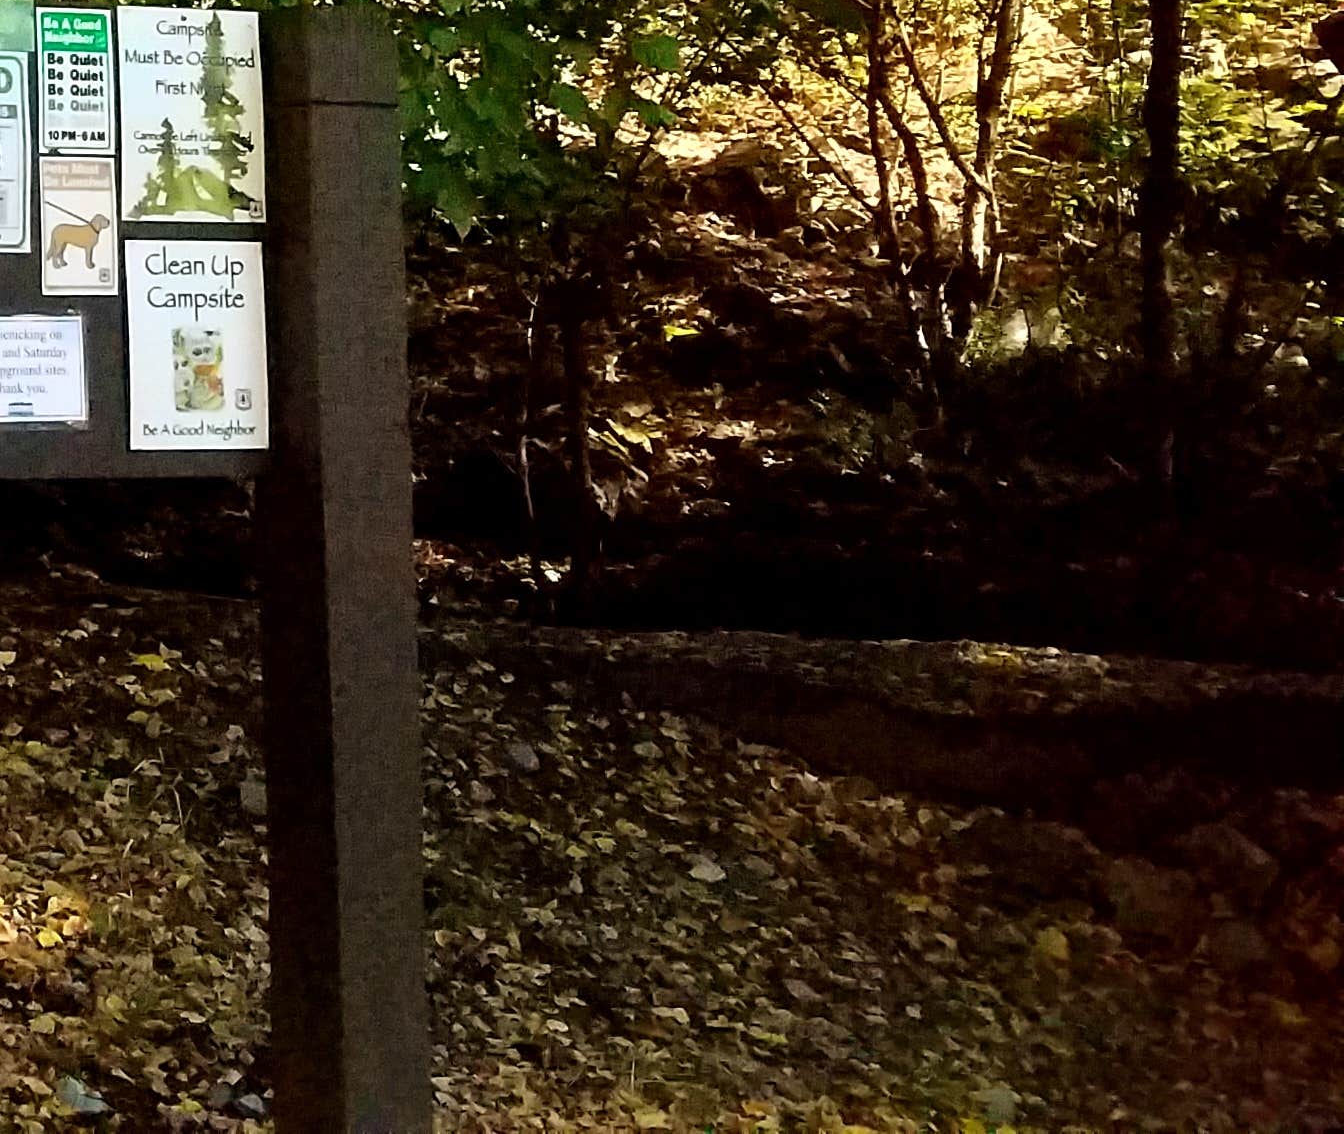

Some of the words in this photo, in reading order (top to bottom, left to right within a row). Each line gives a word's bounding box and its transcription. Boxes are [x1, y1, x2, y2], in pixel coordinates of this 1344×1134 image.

[47, 53, 64, 65] Be
[70, 54, 104, 66] Quiet
[125, 49, 160, 64] Must
[164, 50, 183, 65] Be
[47, 68, 64, 80] Be
[70, 69, 104, 82] Quiet
[47, 84, 64, 95] Be
[70, 84, 104, 97] Quiet
[156, 80, 187, 95] First
[47, 99, 64, 111] Be
[70, 100, 104, 112] Quiet
[48, 131, 59, 140] 10
[90, 131, 105, 141] AM
[145, 246, 205, 276] Clean
[211, 255, 244, 289] Up
[147, 286, 245, 322] Campsite
[2, 347, 21, 358] and
[23, 346, 67, 359] Saturday
[143, 424, 158, 435] Be
[161, 425, 171, 435] A
[173, 420, 204, 435] Good
[207, 420, 256, 440] Neighbor
